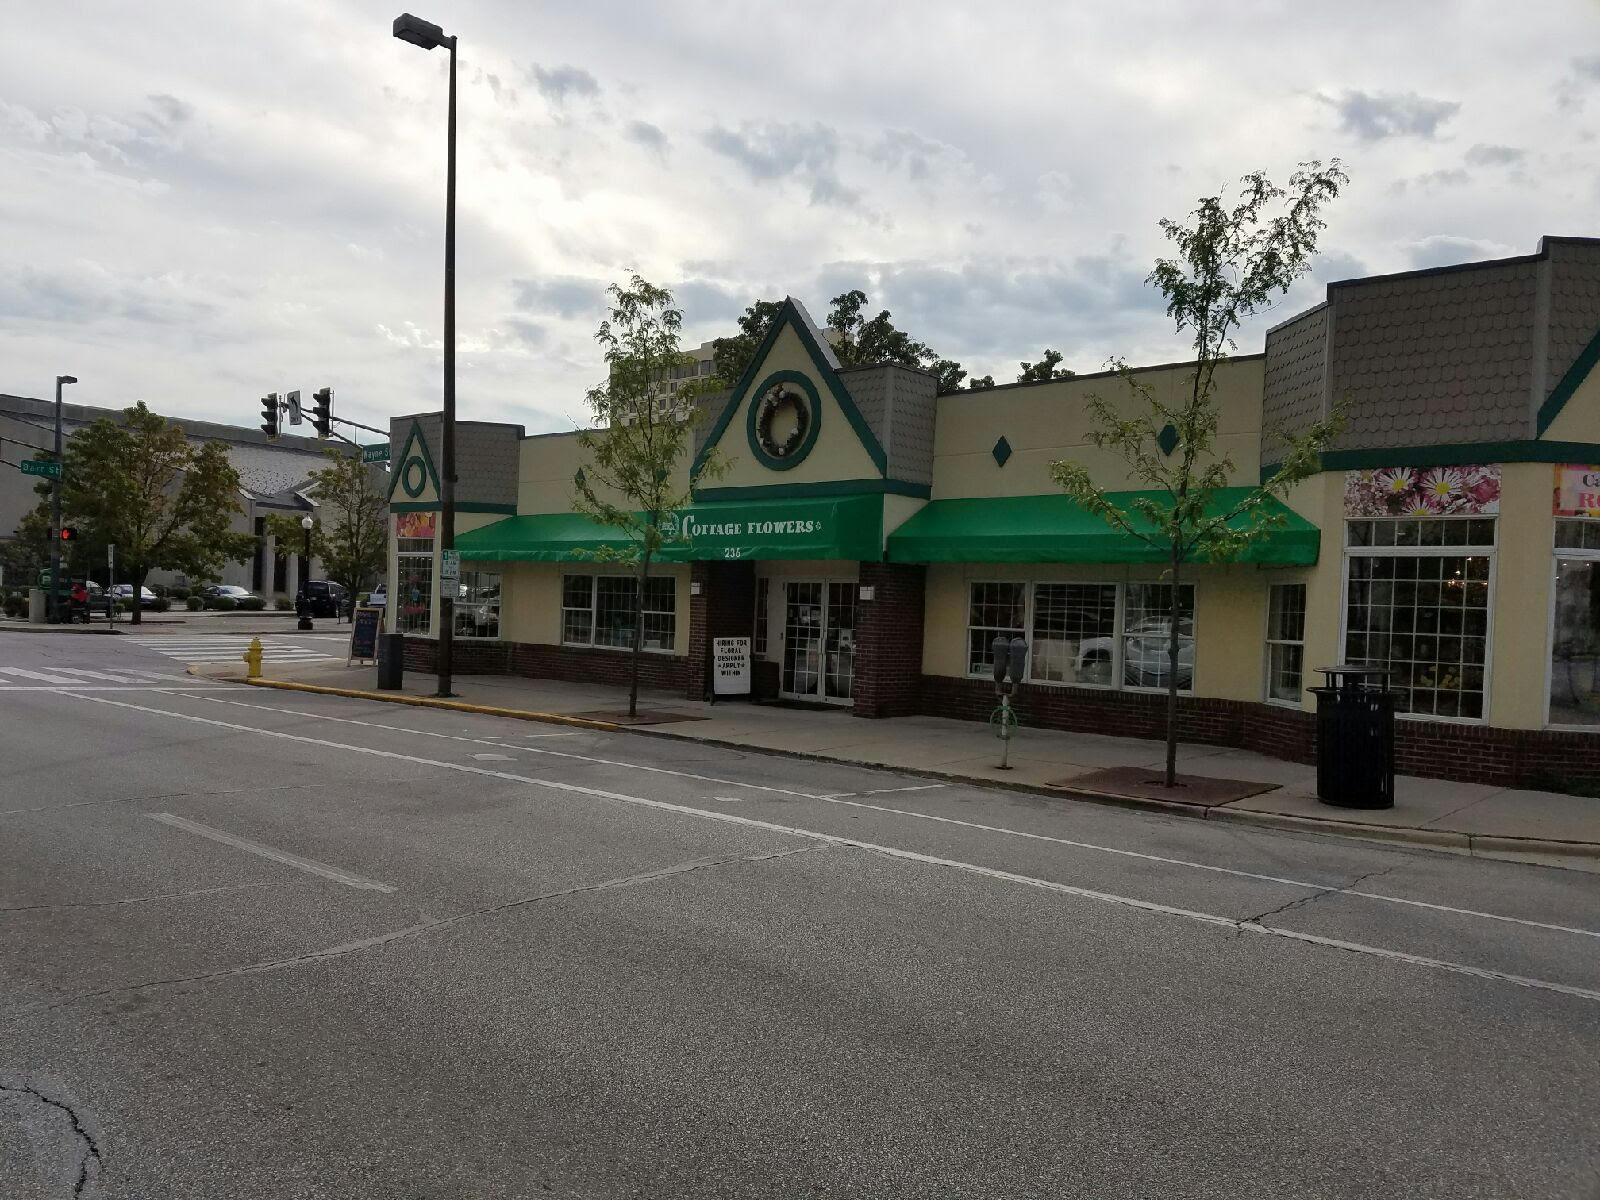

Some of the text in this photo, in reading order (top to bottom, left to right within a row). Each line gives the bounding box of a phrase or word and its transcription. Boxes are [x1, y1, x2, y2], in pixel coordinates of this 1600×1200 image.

[49, 465, 60, 475] St
[747, 520, 814, 534] FLOWERS
[724, 547, 741, 558] 236
